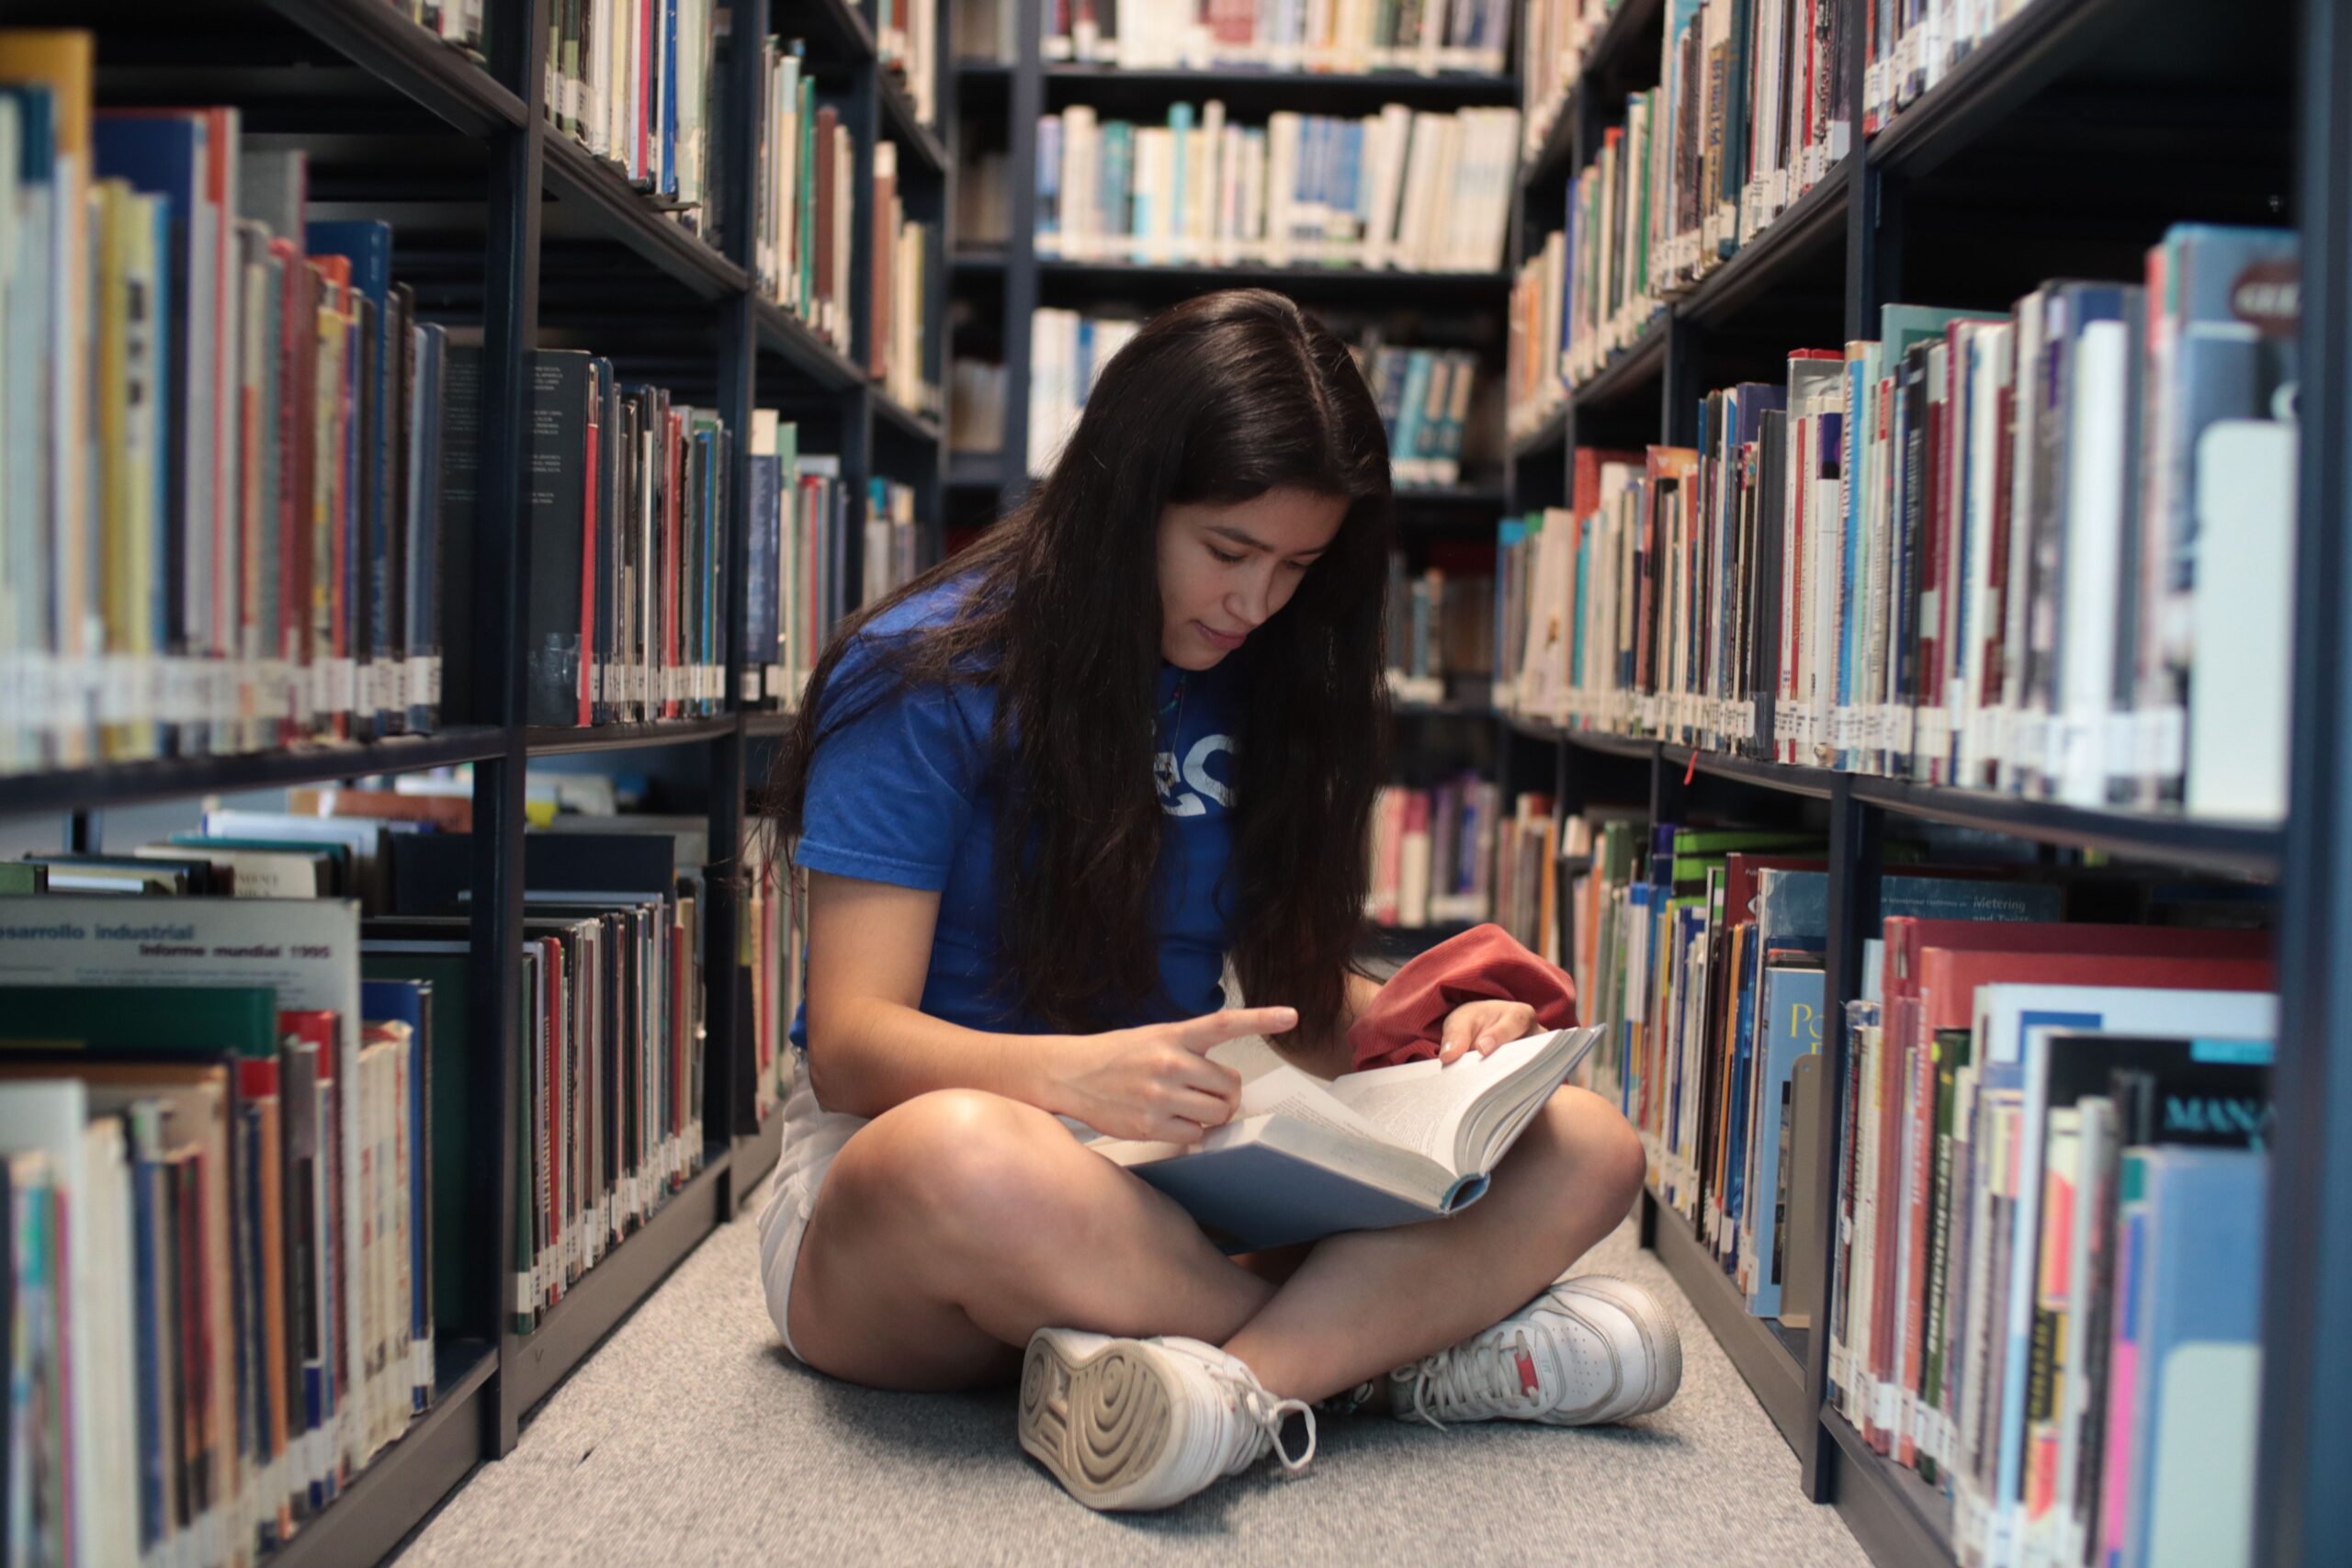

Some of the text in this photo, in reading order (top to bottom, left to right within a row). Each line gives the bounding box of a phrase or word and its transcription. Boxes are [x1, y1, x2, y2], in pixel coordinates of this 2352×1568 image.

[1973, 896, 2027, 912] Metering
[95, 923, 195, 940] industrial
[140, 943, 206, 957] Informe
[213, 944, 281, 958] mundial
